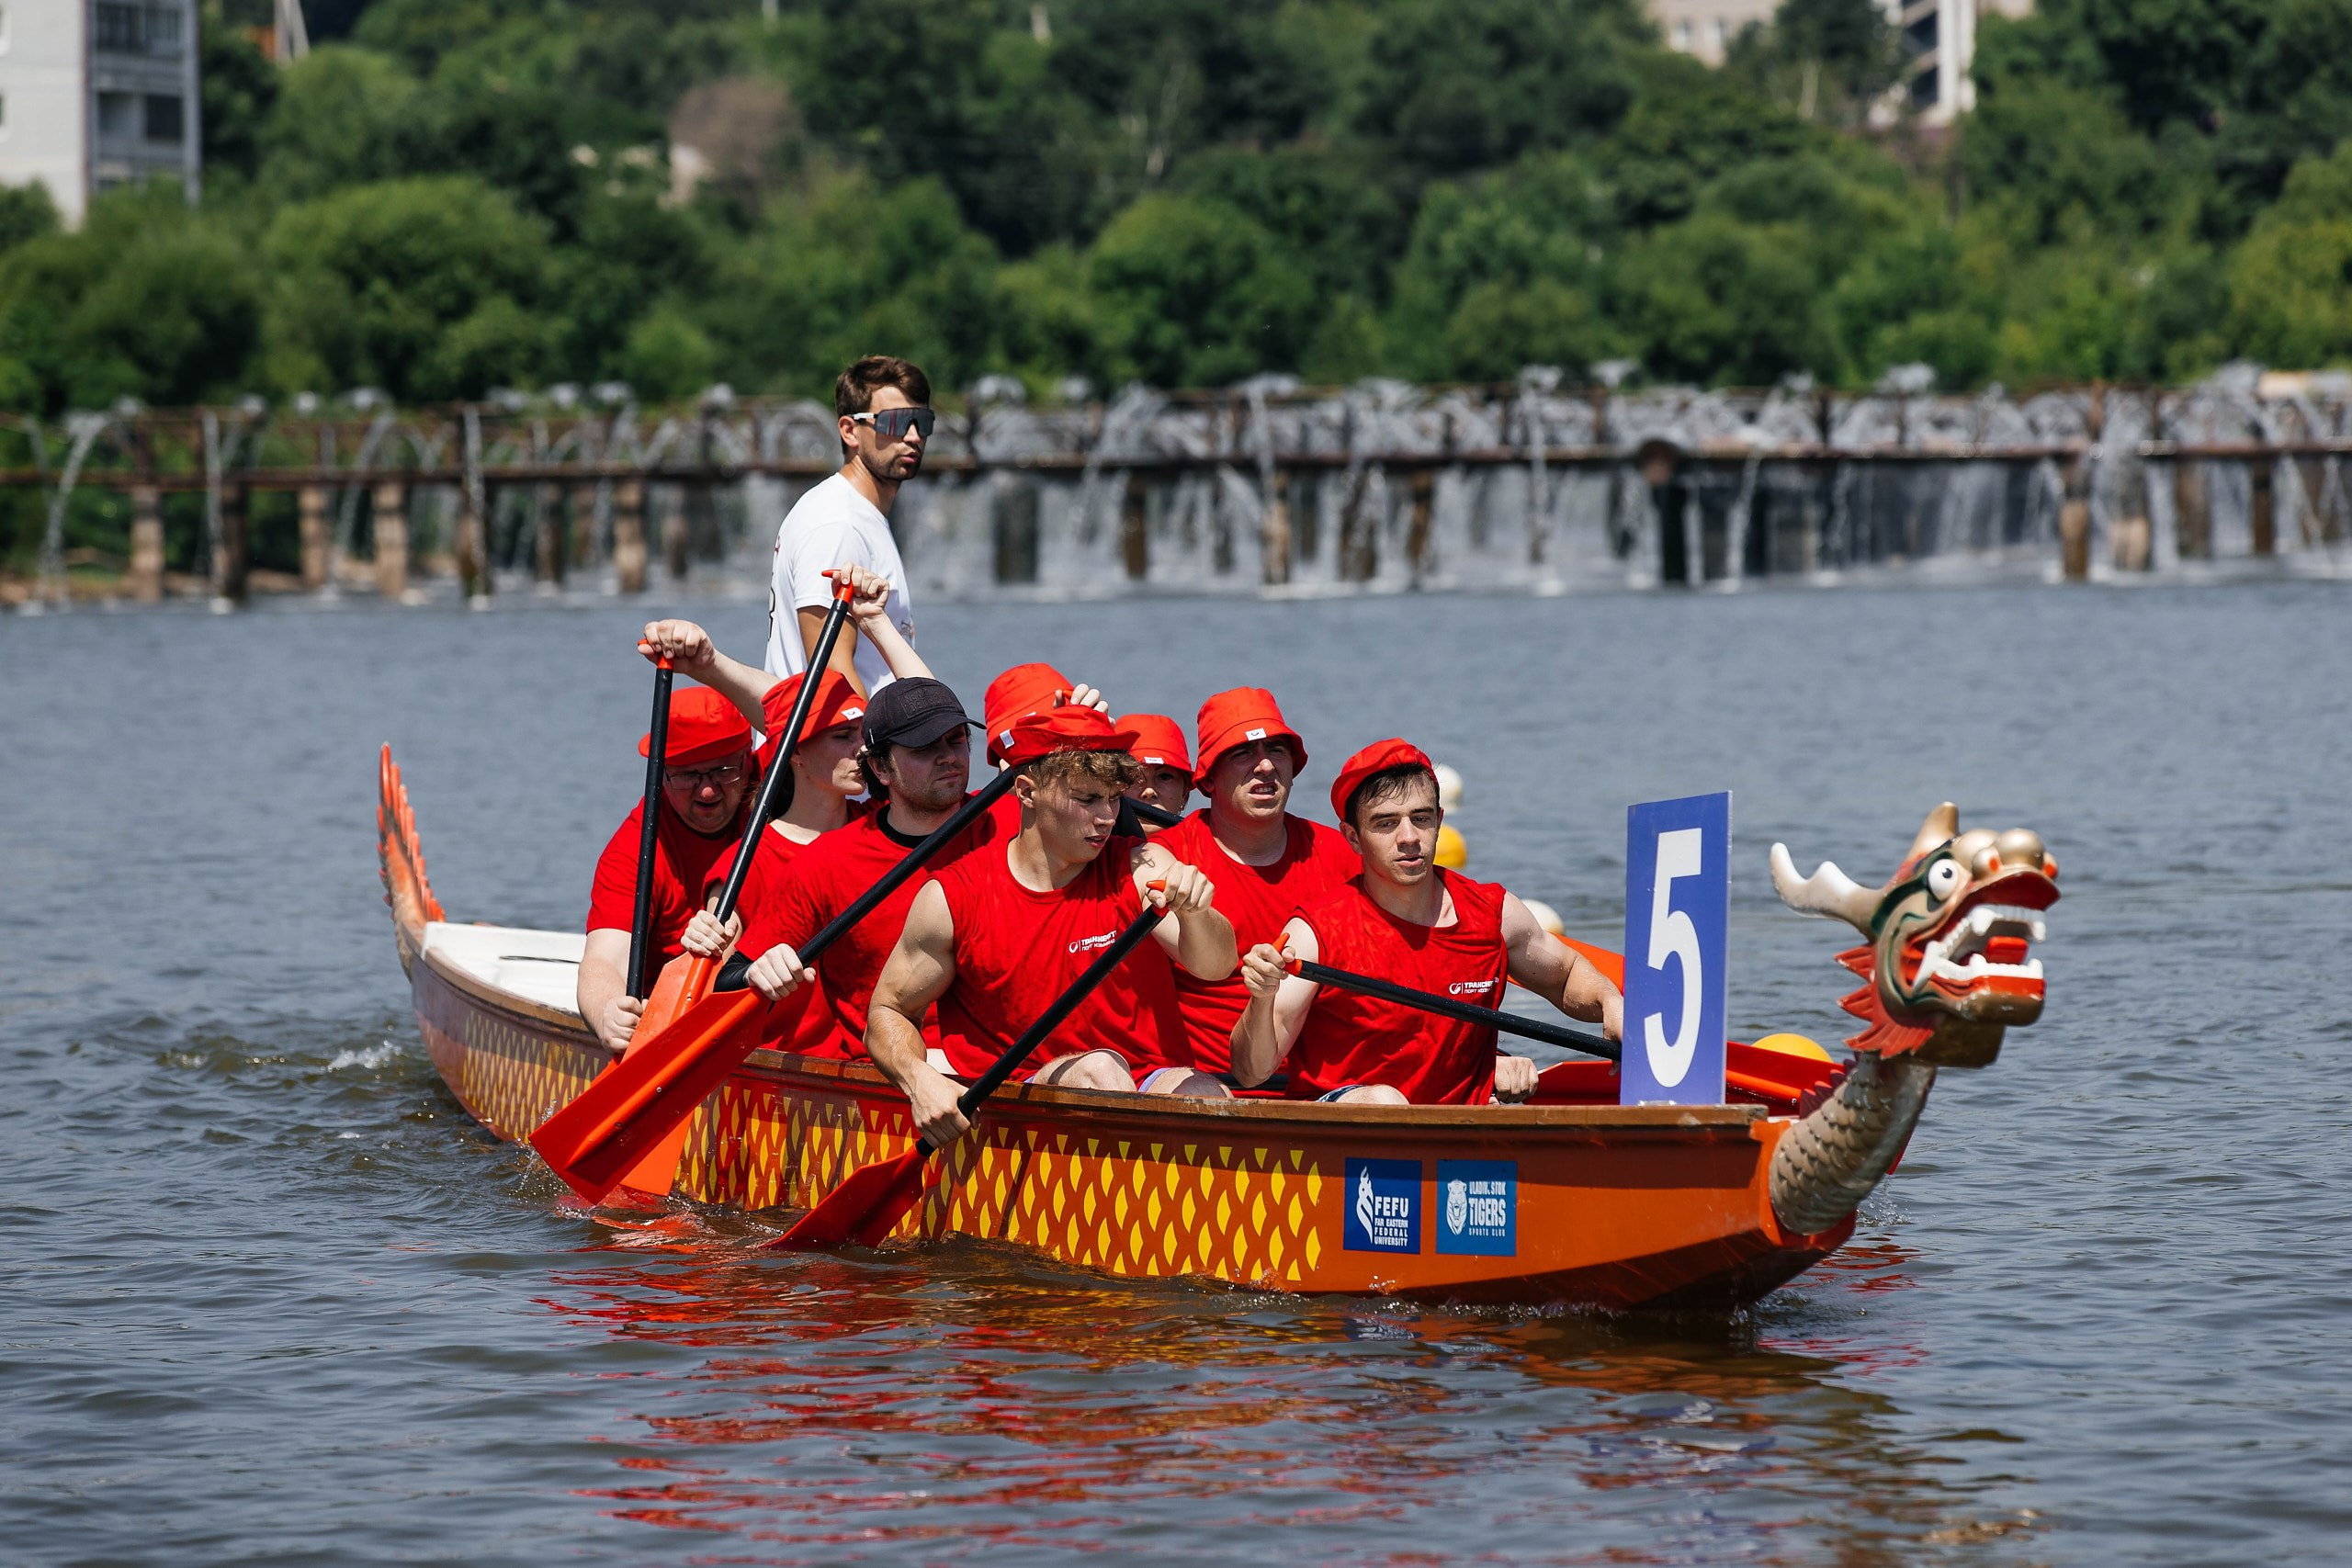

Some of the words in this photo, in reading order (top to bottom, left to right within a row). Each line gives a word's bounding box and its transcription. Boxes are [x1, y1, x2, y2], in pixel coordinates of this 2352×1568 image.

[1644, 828, 1702, 1088] 5
[1469, 1181, 1507, 1195] VLADIVSTOK
[1375, 1196, 1408, 1218] FEFU
[1468, 1198, 1507, 1227] TIGERS
[1374, 1217, 1385, 1227] FAR
[1385, 1218, 1408, 1229] EASTERN
[1374, 1227, 1408, 1237] FEDERAL
[1468, 1227, 1489, 1236] SPORTS
[1491, 1228, 1506, 1237] CLUB
[1374, 1236, 1408, 1247] UNIVERSITY
